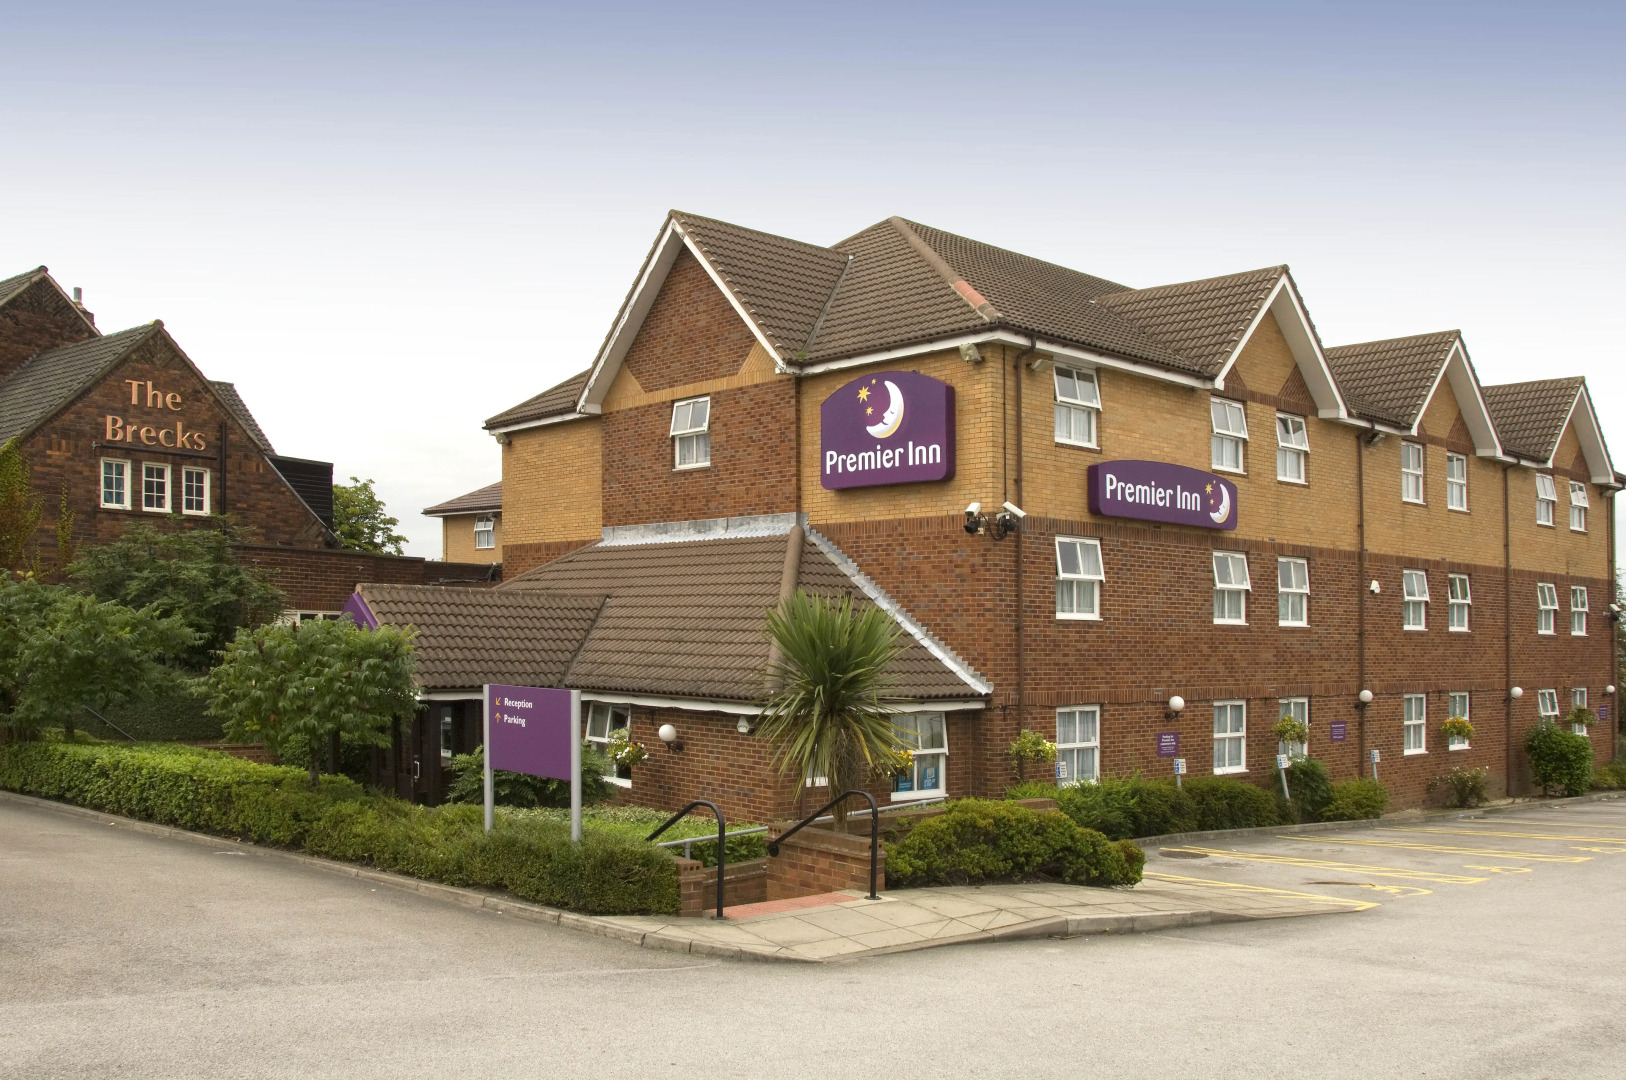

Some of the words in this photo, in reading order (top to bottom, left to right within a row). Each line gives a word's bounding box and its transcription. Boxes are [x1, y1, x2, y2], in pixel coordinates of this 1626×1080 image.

[125, 379, 182, 411] The
[105, 415, 206, 451] Brecks
[825, 444, 904, 475] Premier
[908, 440, 941, 466] Inn
[1105, 473, 1174, 506] Premier
[1176, 484, 1201, 511] Inn
[504, 697, 533, 710] Reception
[503, 714, 526, 728] Parking
